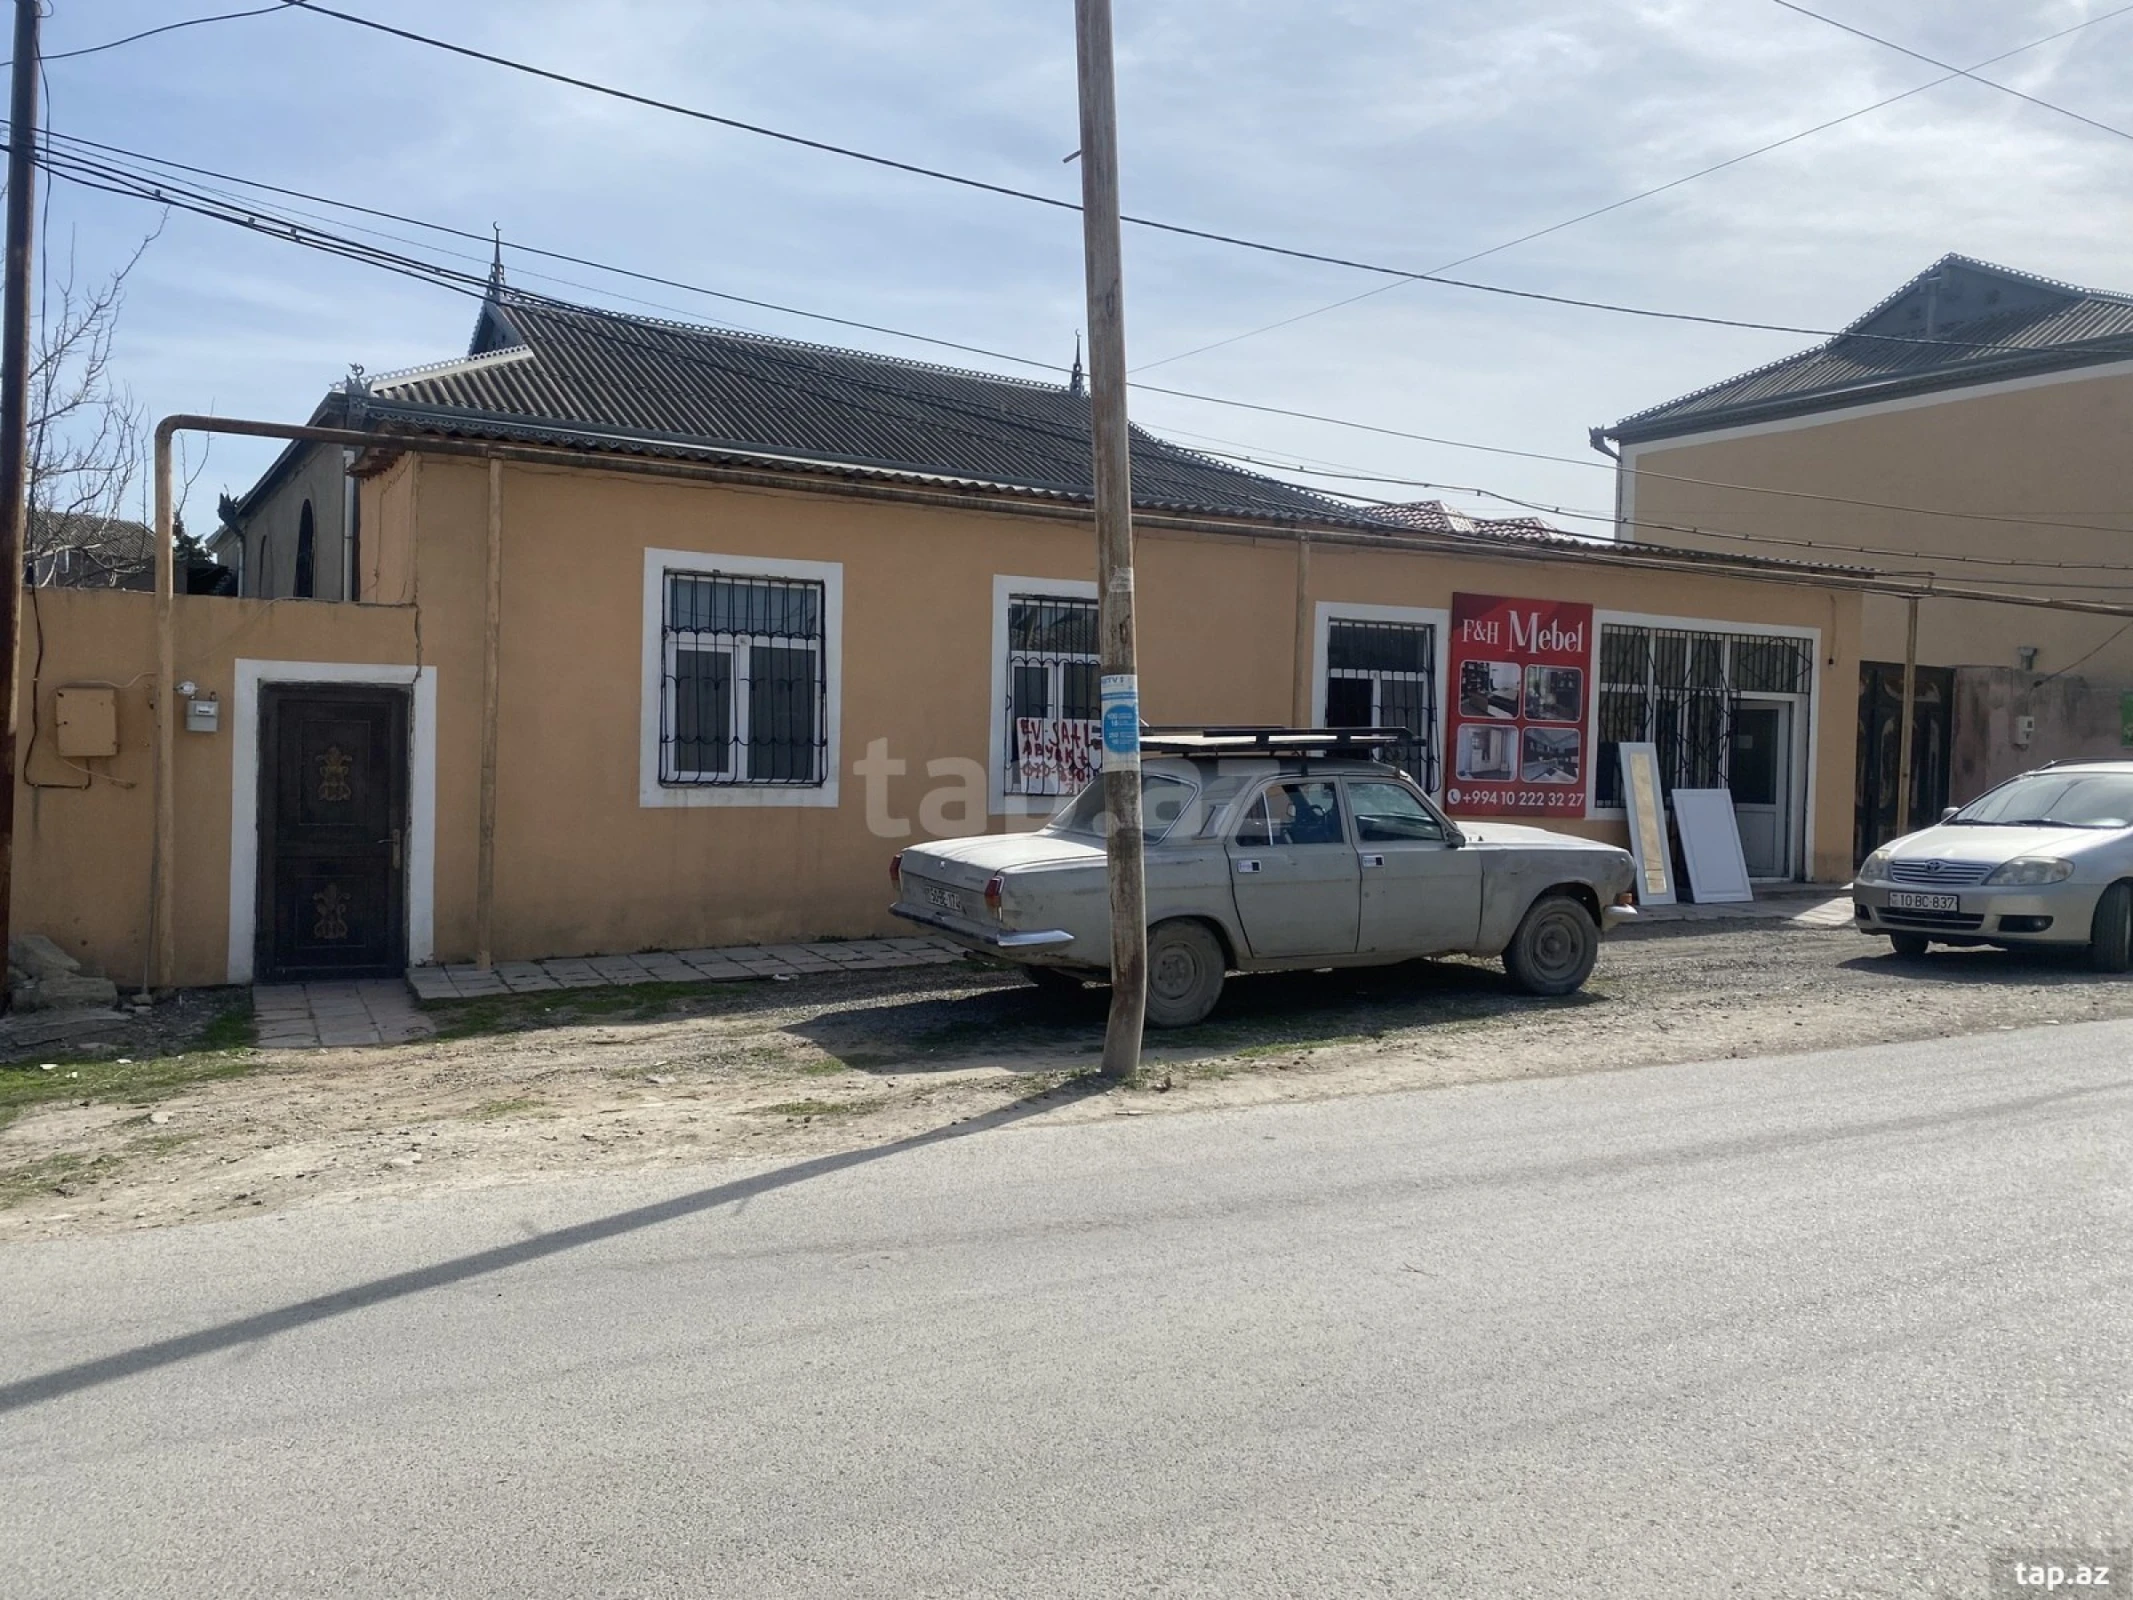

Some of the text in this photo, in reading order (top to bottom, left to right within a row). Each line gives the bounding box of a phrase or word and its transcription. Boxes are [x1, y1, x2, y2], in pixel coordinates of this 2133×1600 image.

[1462, 610, 1584, 653] F&H Mebel
[1463, 790, 1585, 807] +994 10 222 32 27
